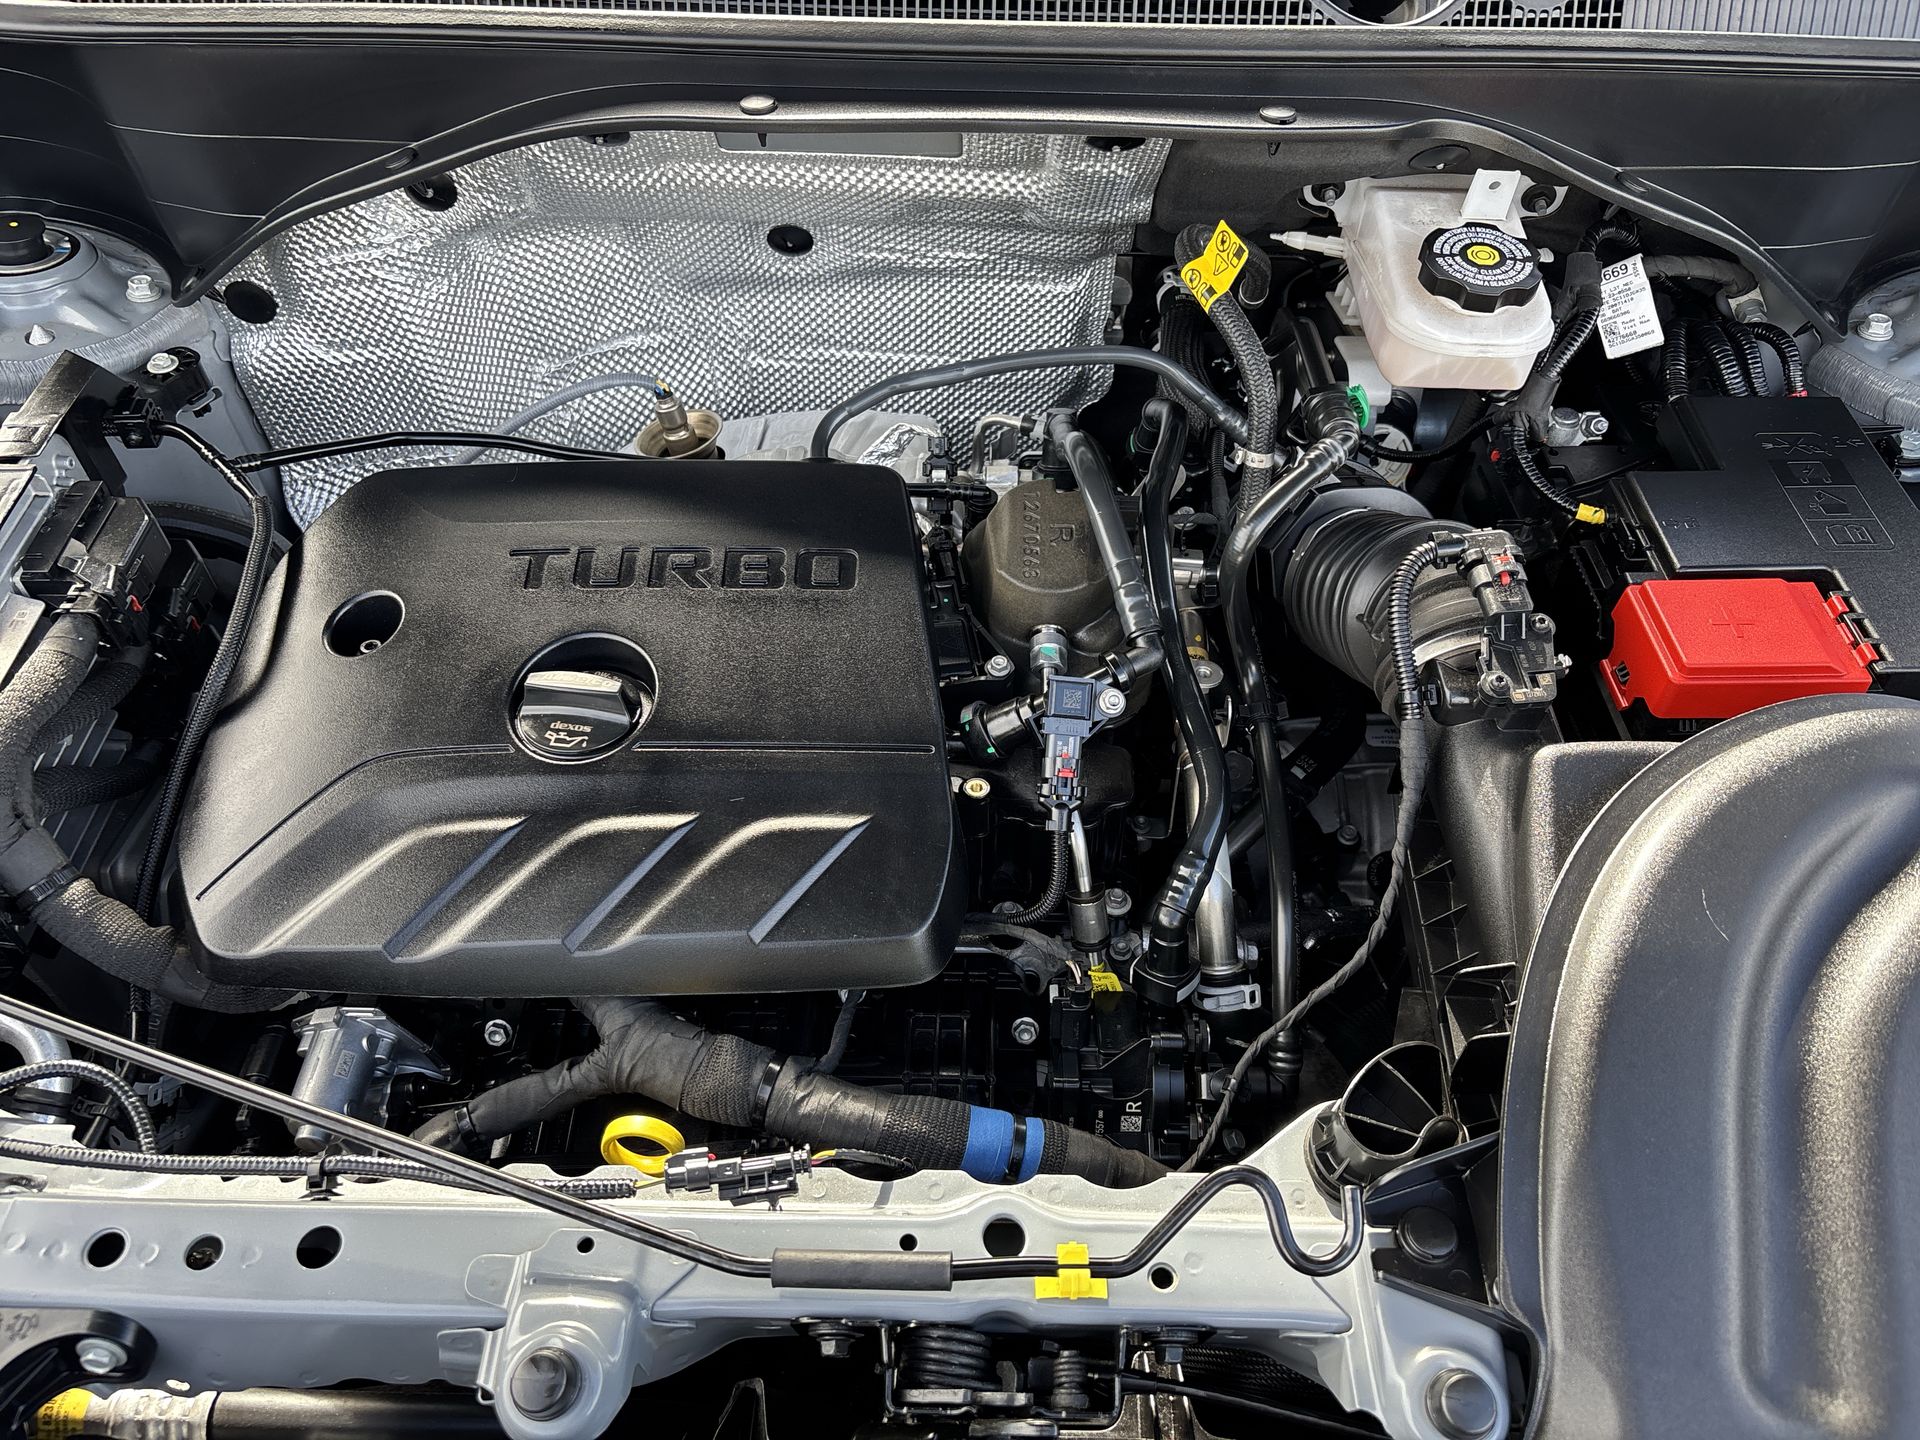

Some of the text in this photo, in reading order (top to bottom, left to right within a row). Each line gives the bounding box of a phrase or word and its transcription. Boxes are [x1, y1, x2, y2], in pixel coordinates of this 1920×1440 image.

[1446, 266, 1463, 279] FLUID
[1464, 275, 1484, 286] FROM
[1489, 278, 1512, 287] SEALED
[1479, 268, 1501, 276] CLEAN
[1050, 523, 1075, 546] R
[509, 546, 860, 591] TURBO
[550, 721, 593, 733] dexos
[1126, 1101, 1142, 1113] R
